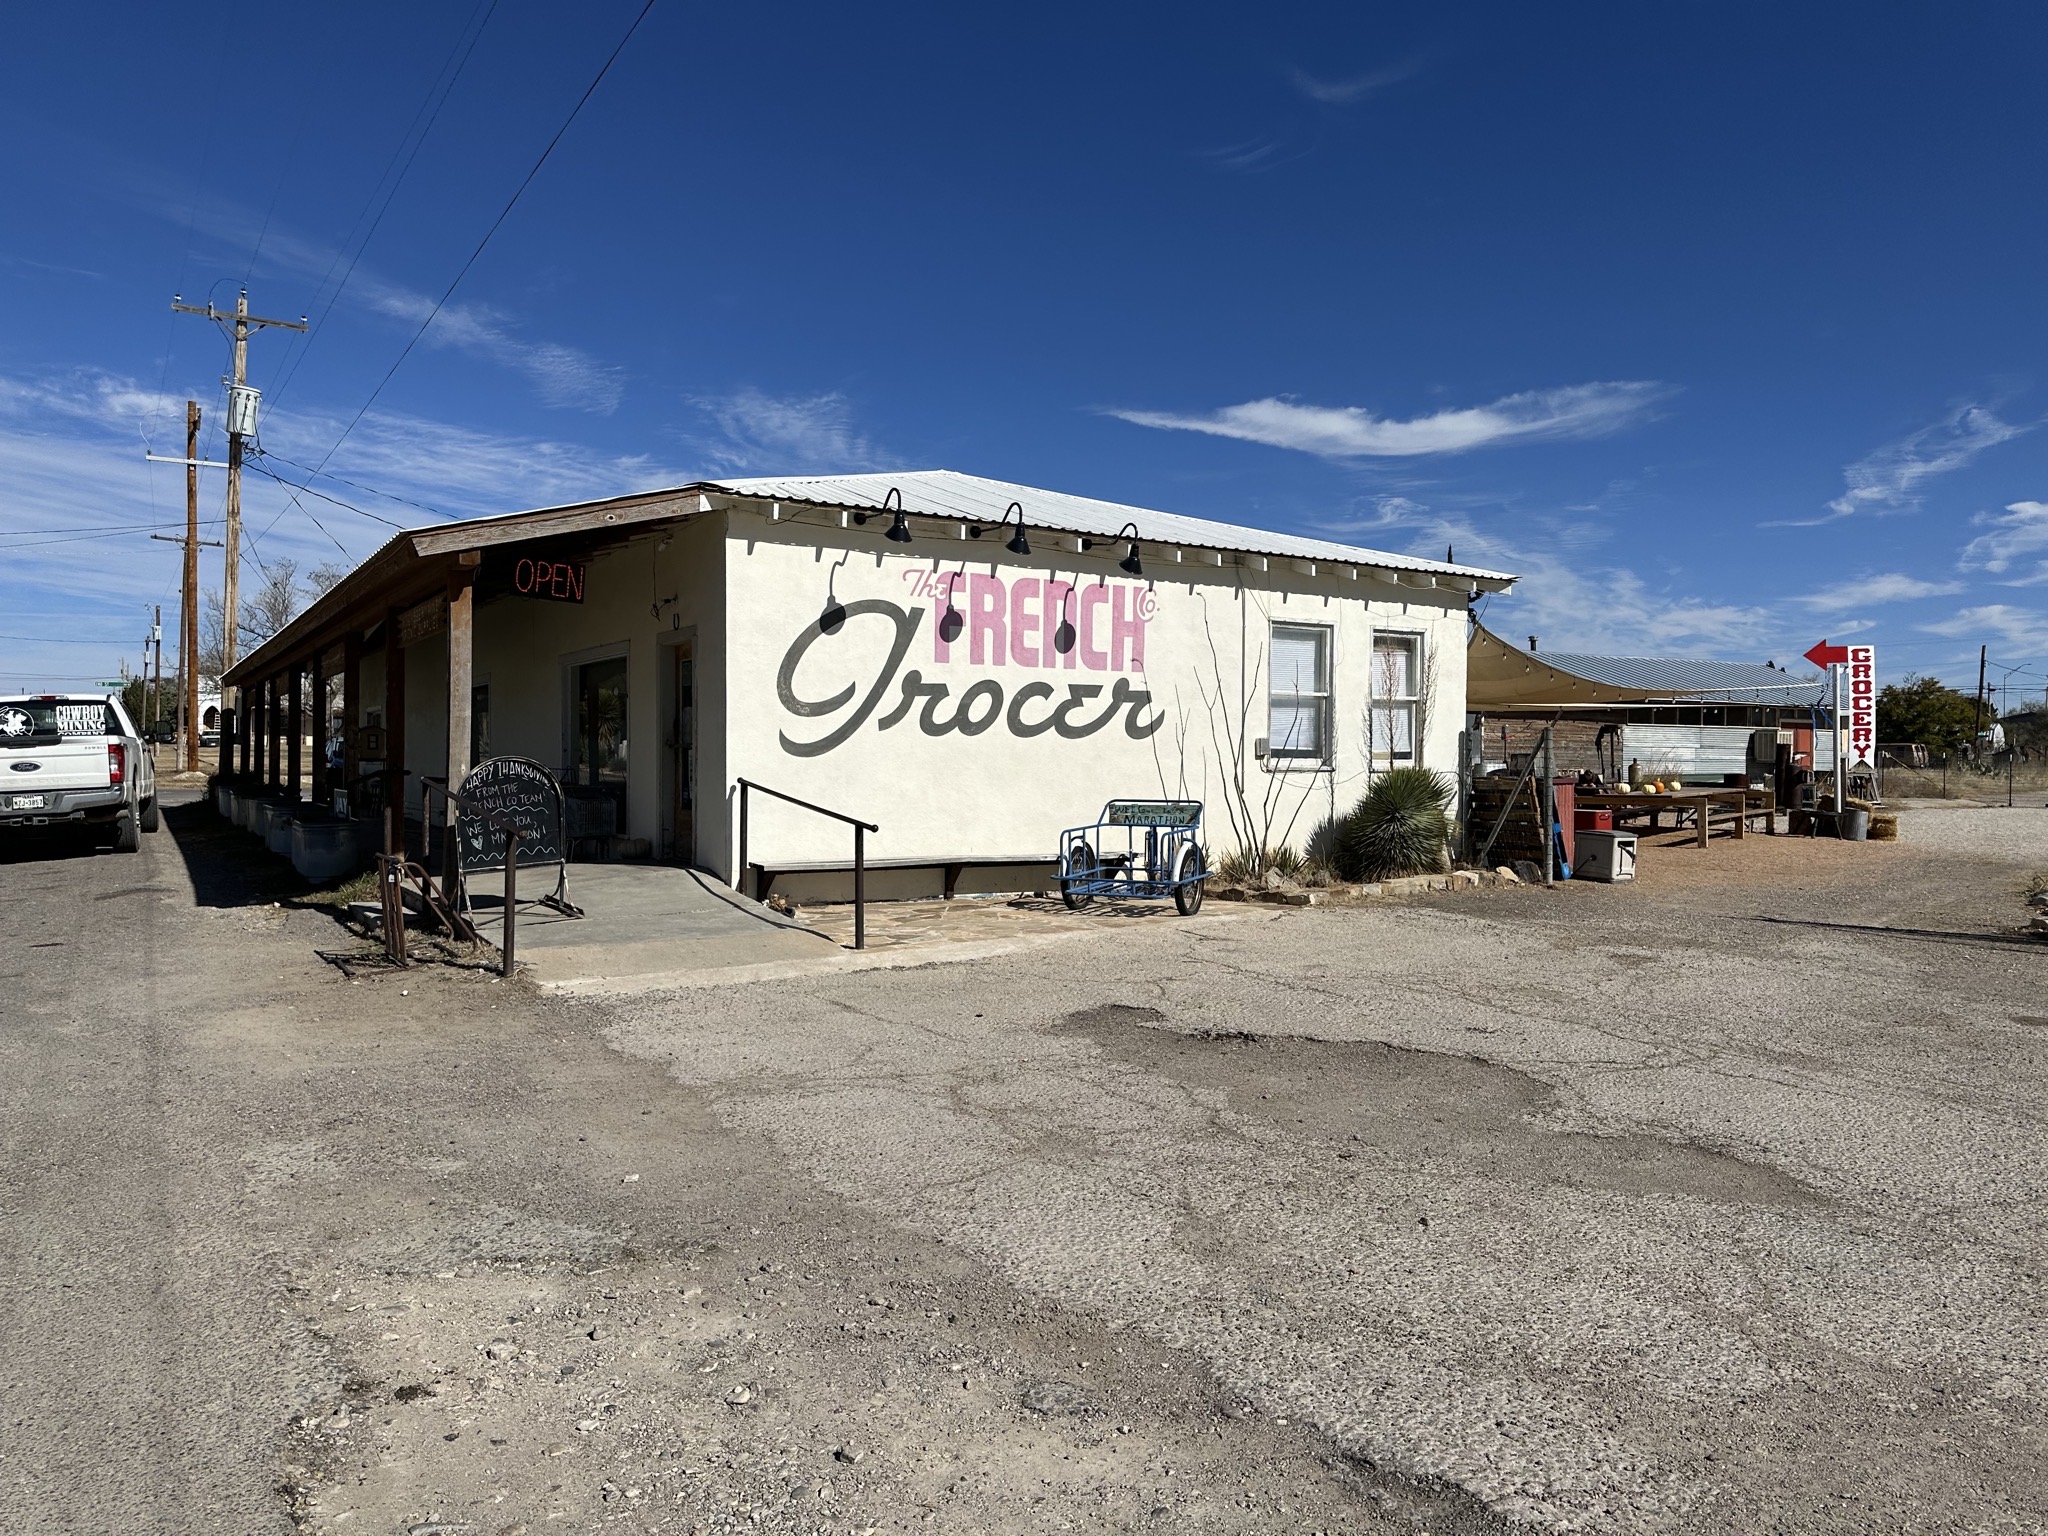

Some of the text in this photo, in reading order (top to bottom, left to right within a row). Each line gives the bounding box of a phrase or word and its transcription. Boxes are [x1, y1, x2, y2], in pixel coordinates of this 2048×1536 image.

[515, 558, 583, 600] OPEN
[902, 568, 947, 599] The
[934, 569, 1145, 673] FRENCH
[776, 598, 1166, 758] Grocer
[1850, 648, 1873, 758] GROCERY
[56, 705, 106, 720] COWBOY
[57, 721, 106, 730] MINING
[466, 764, 494, 789] HAPPY
[476, 782, 519, 798] FROM THE
[506, 796, 517, 806] CO
[1123, 815, 1185, 825] MARATHON
[465, 822, 484, 837] WE
